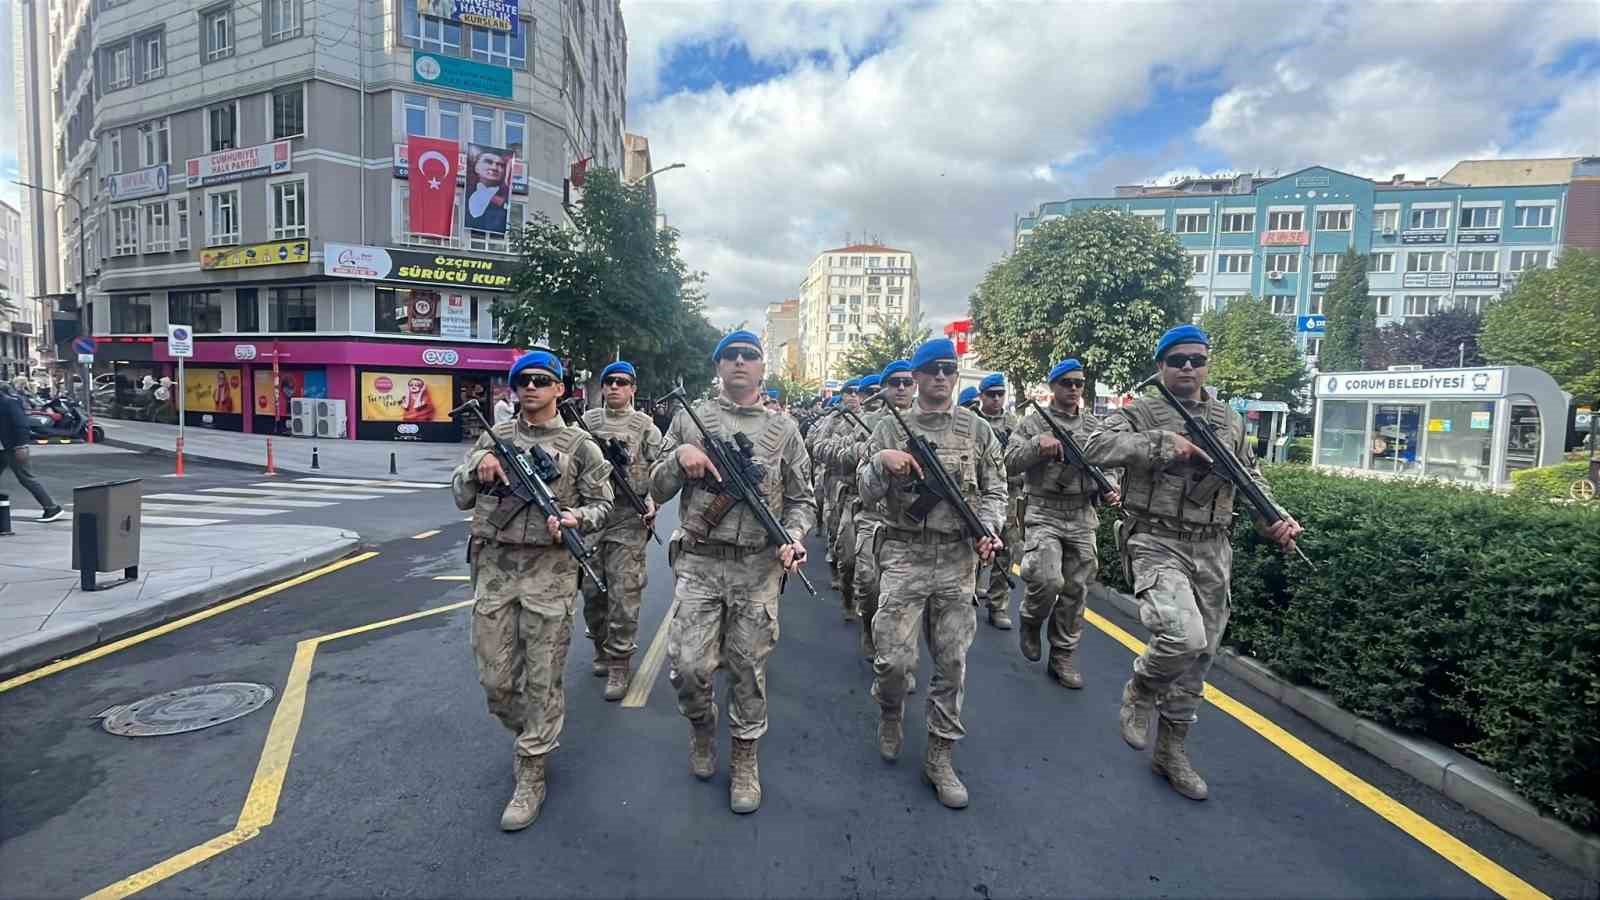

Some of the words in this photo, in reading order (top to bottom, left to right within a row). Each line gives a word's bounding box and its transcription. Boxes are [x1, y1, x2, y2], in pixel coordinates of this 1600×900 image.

[435, 256, 493, 270] ÖZÇETİN
[398, 265, 468, 282] SÜRÜCÜ
[424, 350, 458, 364] eve
[1344, 379, 1385, 391] ÇORUM
[1387, 374, 1465, 390] BELEDİYESİ
